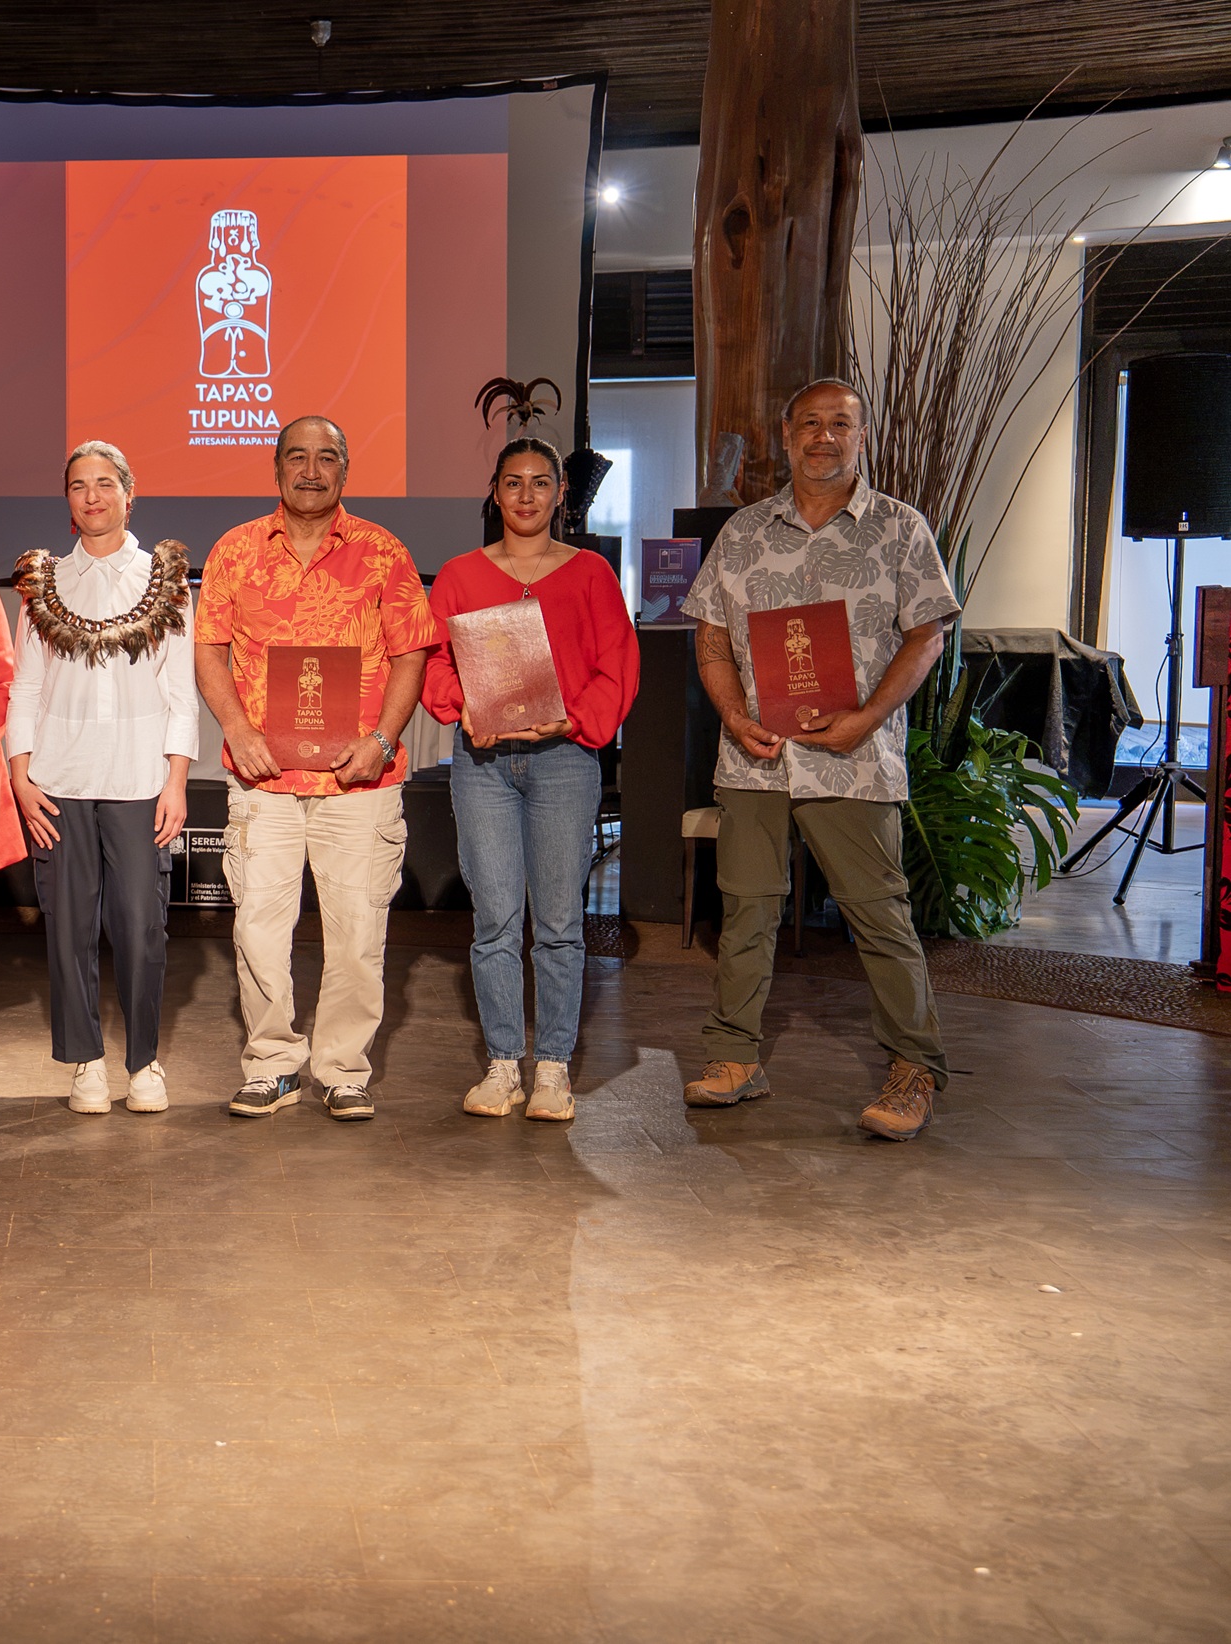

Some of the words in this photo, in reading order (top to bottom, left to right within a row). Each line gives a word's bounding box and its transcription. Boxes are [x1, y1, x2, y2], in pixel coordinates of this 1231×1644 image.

[195, 383, 273, 402] TAPA'O
[188, 409, 281, 428] TUPUNA
[188, 435, 237, 446] ARTESANÍA
[239, 437, 263, 446] RAPA
[264, 437, 278, 446] NU
[789, 672, 816, 682] TAPA'O
[787, 680, 820, 690] TUPUNA
[297, 709, 322, 717] TAPA'O
[294, 717, 325, 725] TUPUNA
[191, 837, 225, 846] SEREM
